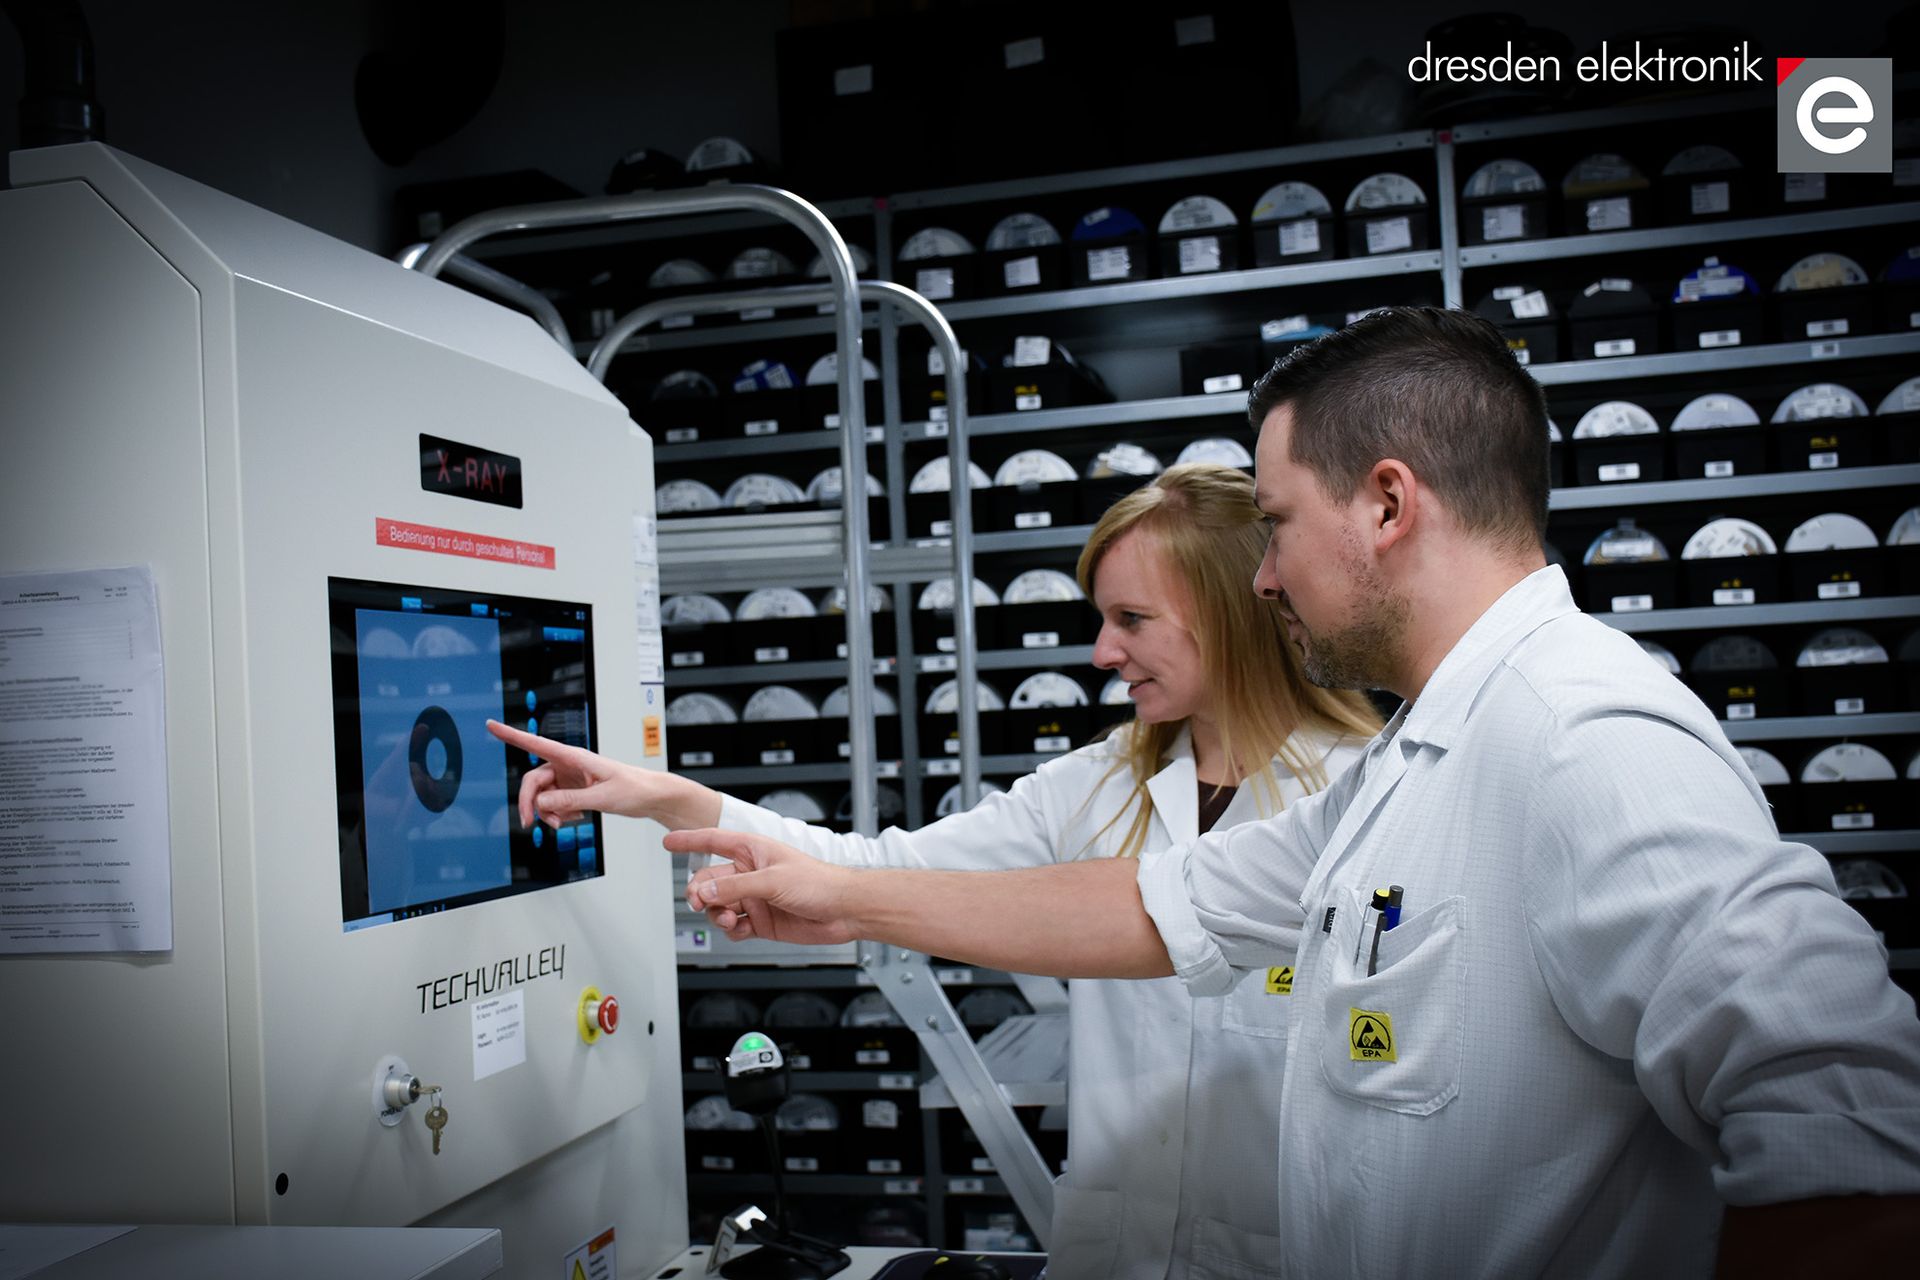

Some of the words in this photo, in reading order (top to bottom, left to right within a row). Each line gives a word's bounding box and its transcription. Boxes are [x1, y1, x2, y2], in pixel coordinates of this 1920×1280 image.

[436, 448, 507, 495] X-RAY
[389, 526, 436, 548] Bedienung
[437, 536, 451, 548] nur
[452, 537, 475, 553] durch
[475, 542, 515, 560] geschultes
[416, 944, 565, 1014] TECHVALLEY
[1362, 1049, 1382, 1058] EPA
